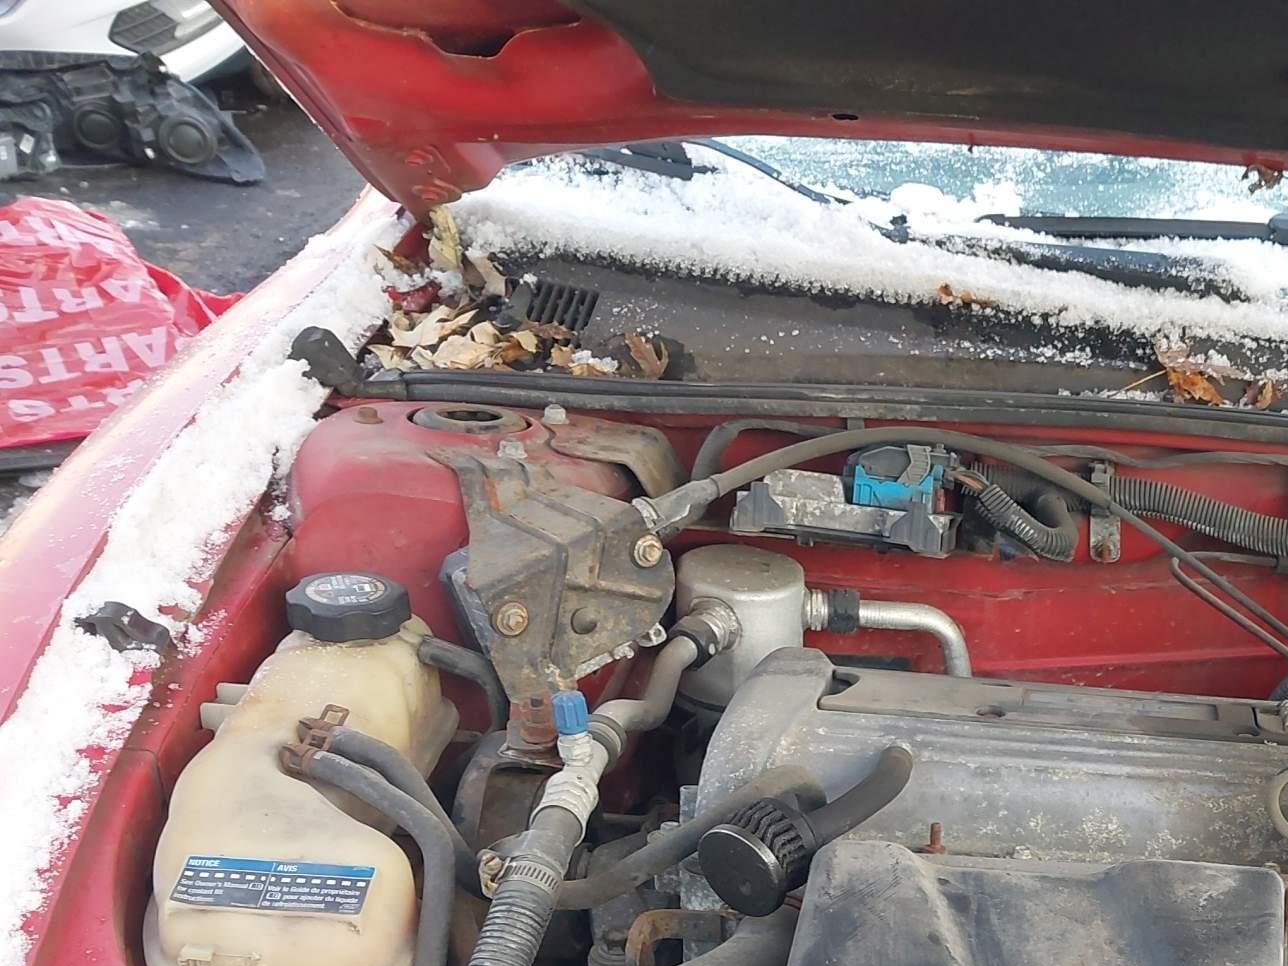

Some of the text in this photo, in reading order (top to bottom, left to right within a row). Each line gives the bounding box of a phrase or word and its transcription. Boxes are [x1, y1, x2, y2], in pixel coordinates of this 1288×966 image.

[0, 327, 176, 388] ARTS
[187, 858, 221, 867] NOTICE
[276, 864, 298, 872] AVIS
